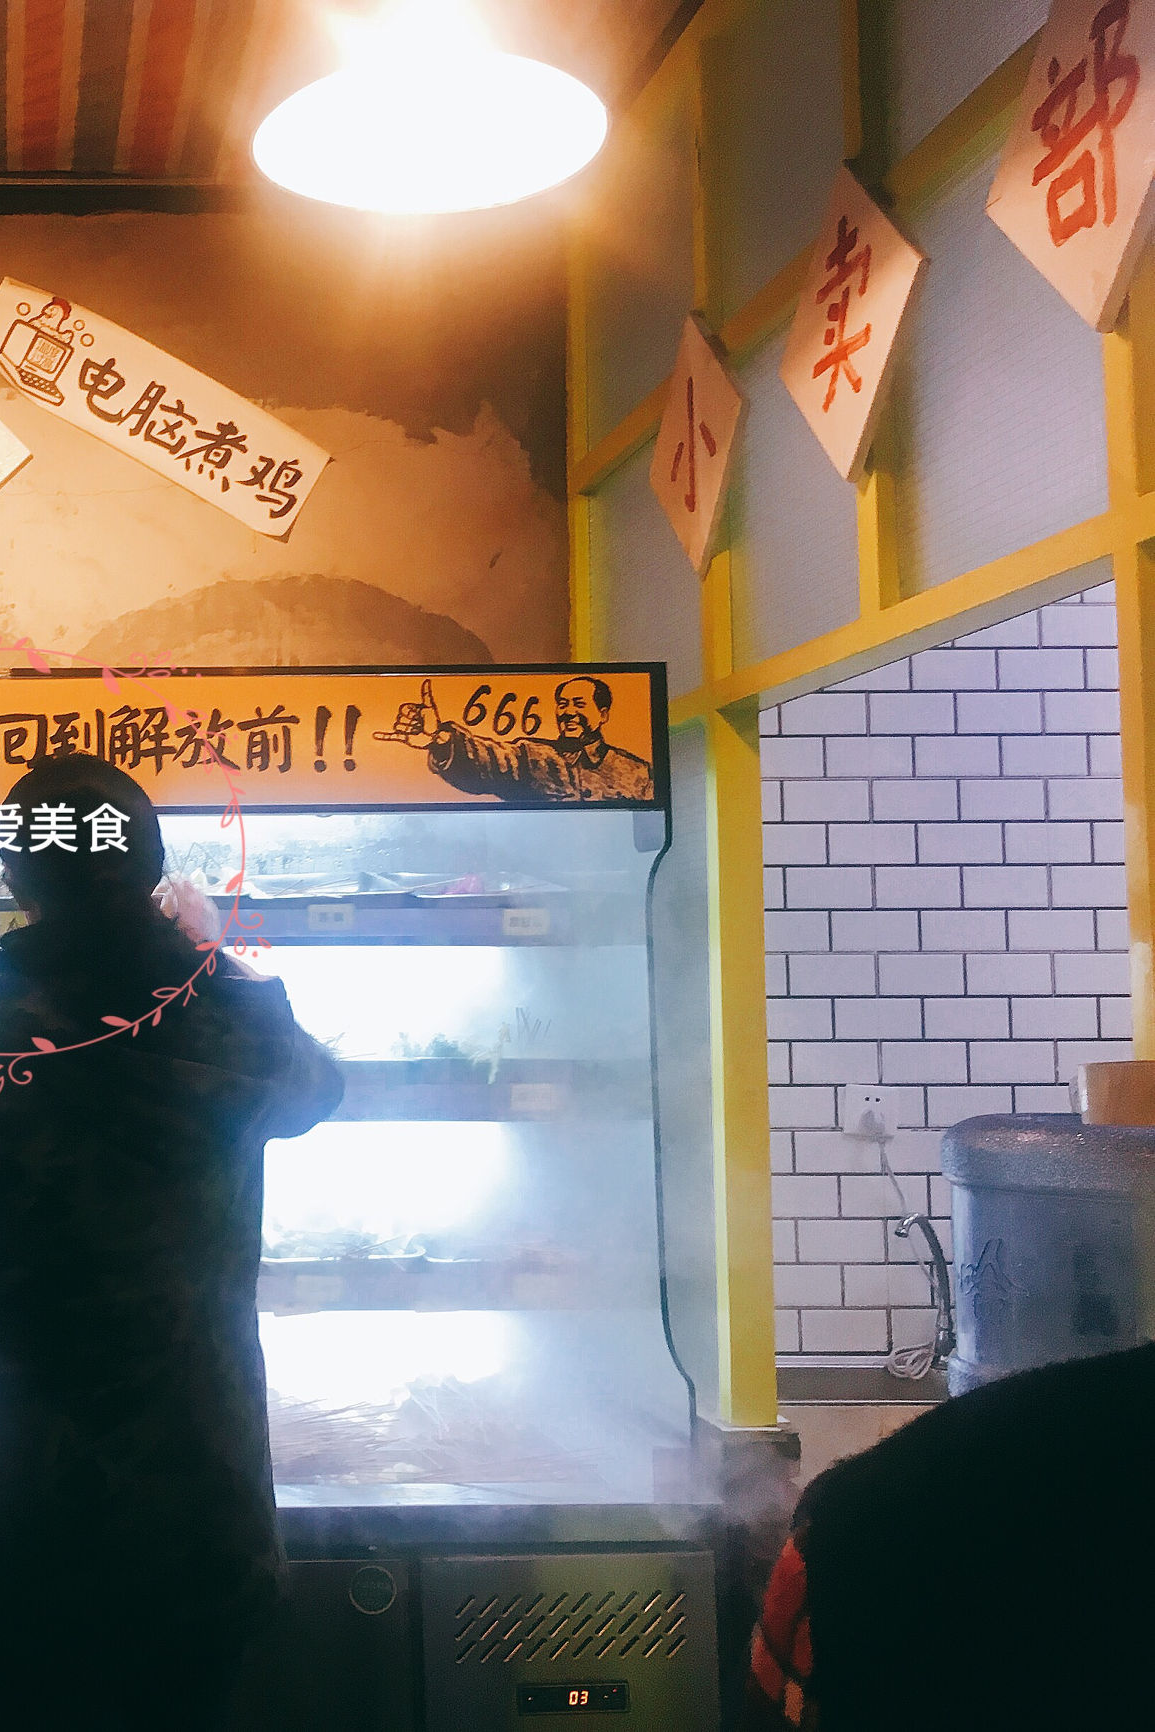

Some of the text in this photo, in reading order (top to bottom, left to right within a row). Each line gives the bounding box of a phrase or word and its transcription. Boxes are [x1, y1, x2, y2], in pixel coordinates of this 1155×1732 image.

[1031, 0, 1141, 247] 部
[811, 215, 872, 414] 卖
[77, 356, 304, 519] 电脑煮鸡
[670, 376, 717, 513] 小
[462, 684, 543, 737] 666
[568, 1690, 589, 1706] 03
